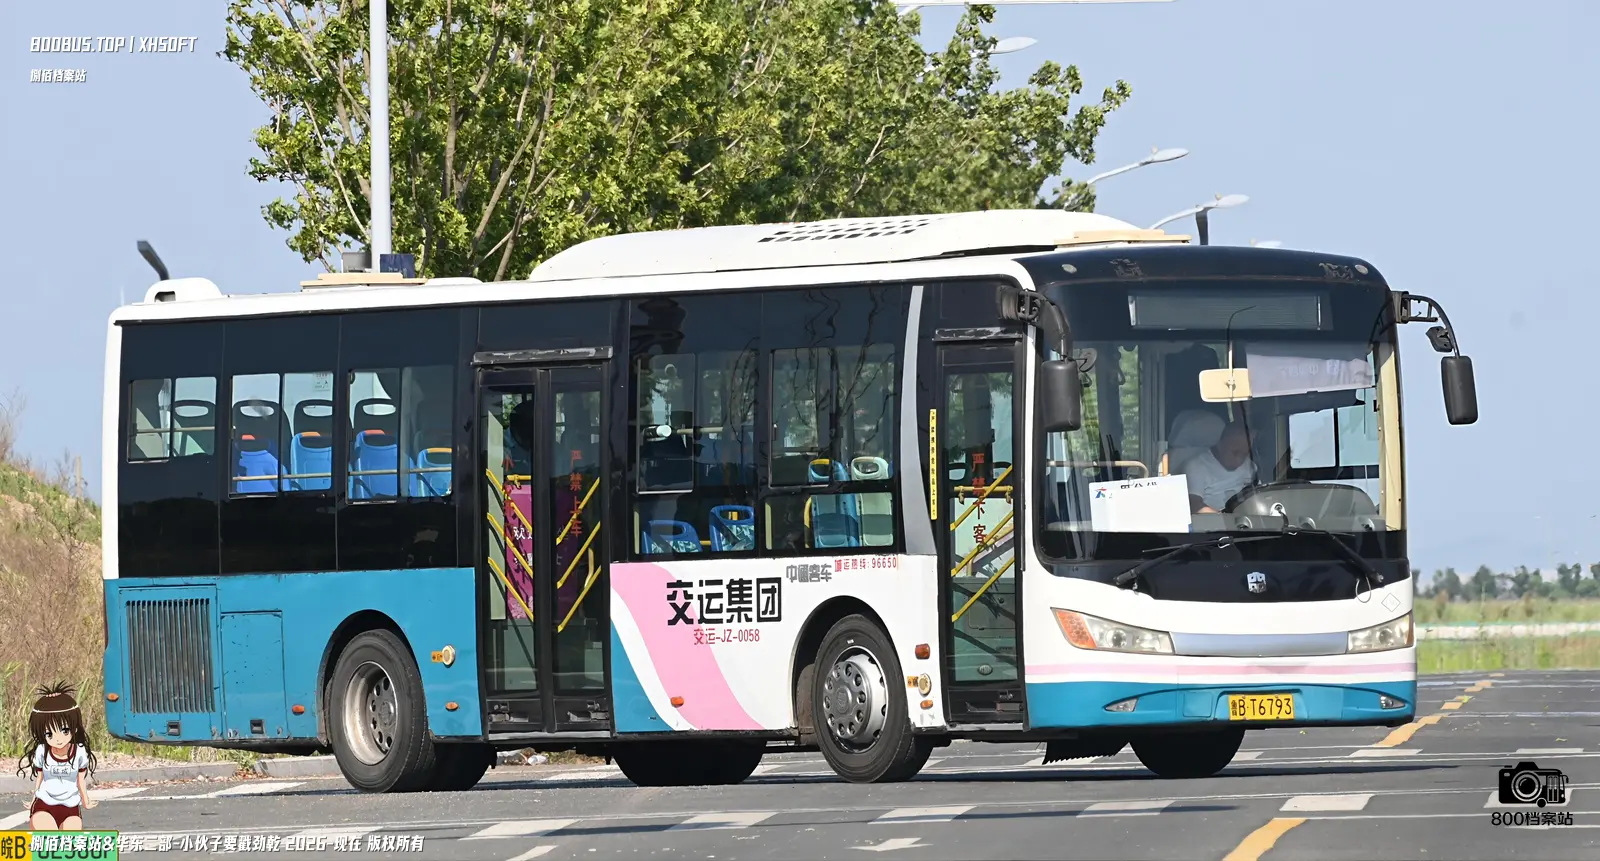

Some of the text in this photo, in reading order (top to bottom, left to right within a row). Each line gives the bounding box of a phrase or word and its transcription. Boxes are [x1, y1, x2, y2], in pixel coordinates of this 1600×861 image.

[569, 449, 584, 538] 严禁上车
[971, 453, 988, 545] 严禁下客
[666, 577, 783, 626] 交运集团
[693, 628, 761, 646] 交运-JZ-0058
